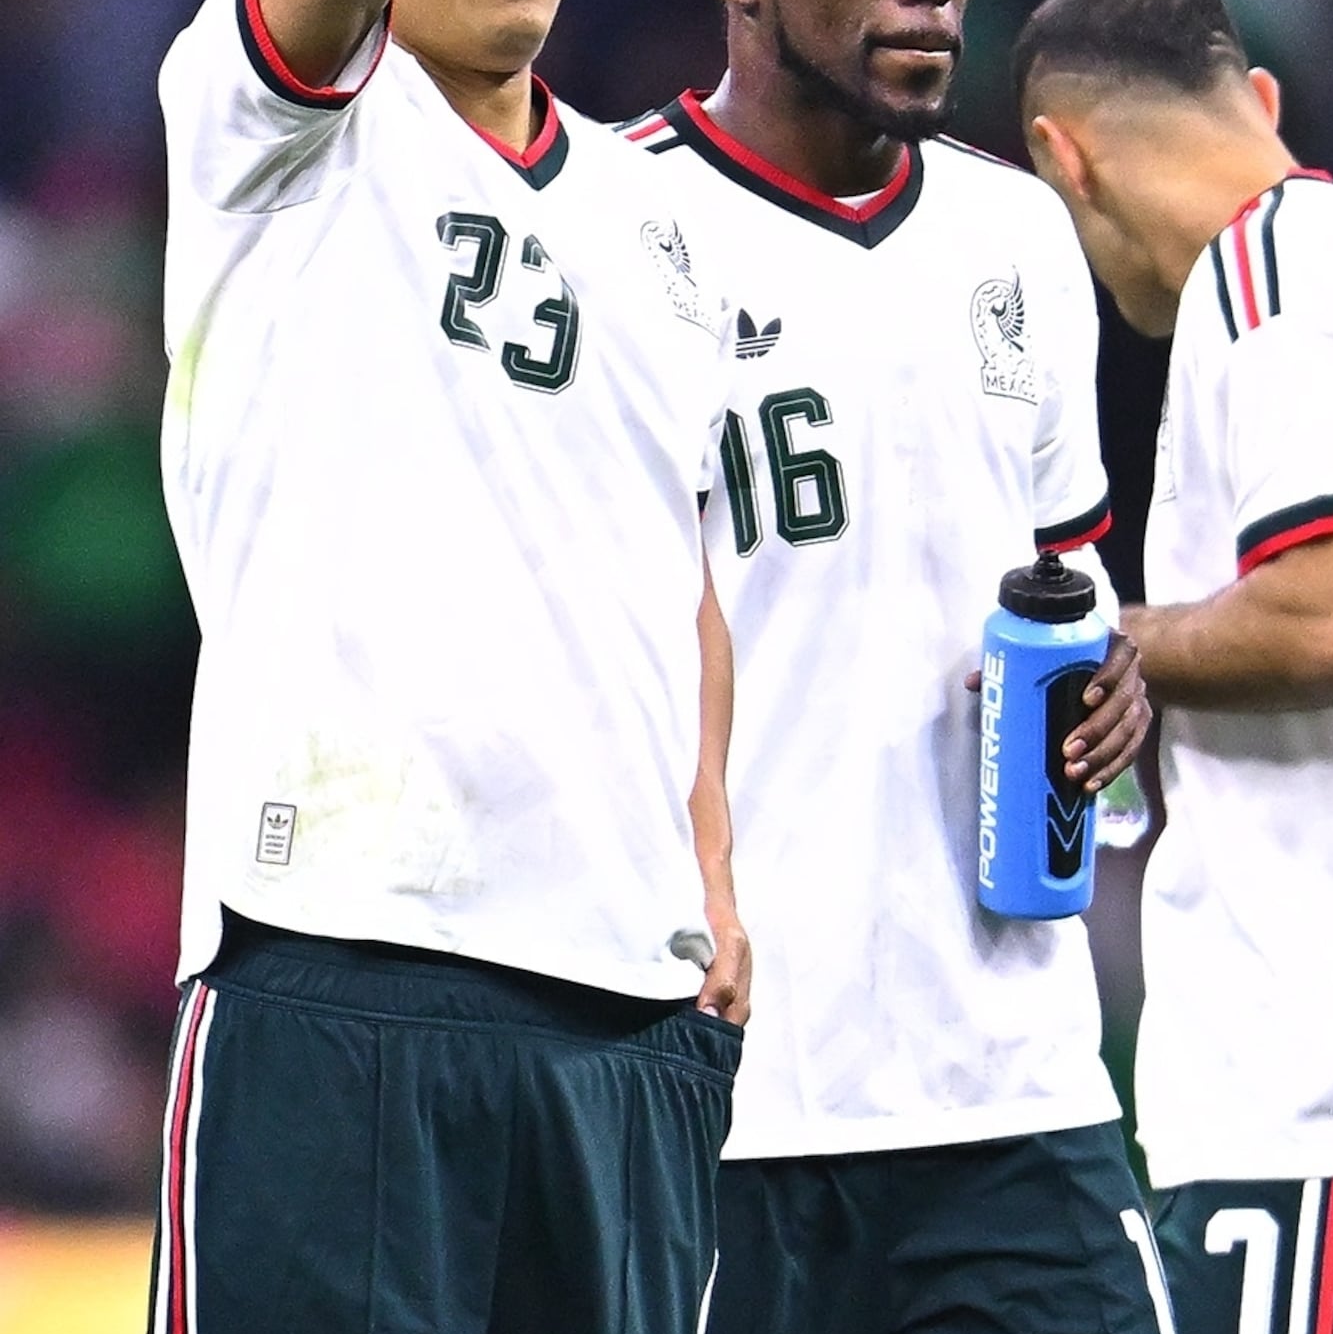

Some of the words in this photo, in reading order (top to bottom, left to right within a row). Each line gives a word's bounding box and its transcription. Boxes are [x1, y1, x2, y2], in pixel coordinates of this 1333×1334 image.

[435, 212, 581, 394] 23
[720, 387, 850, 558] 16
[978, 650, 1005, 890] POWERADE
